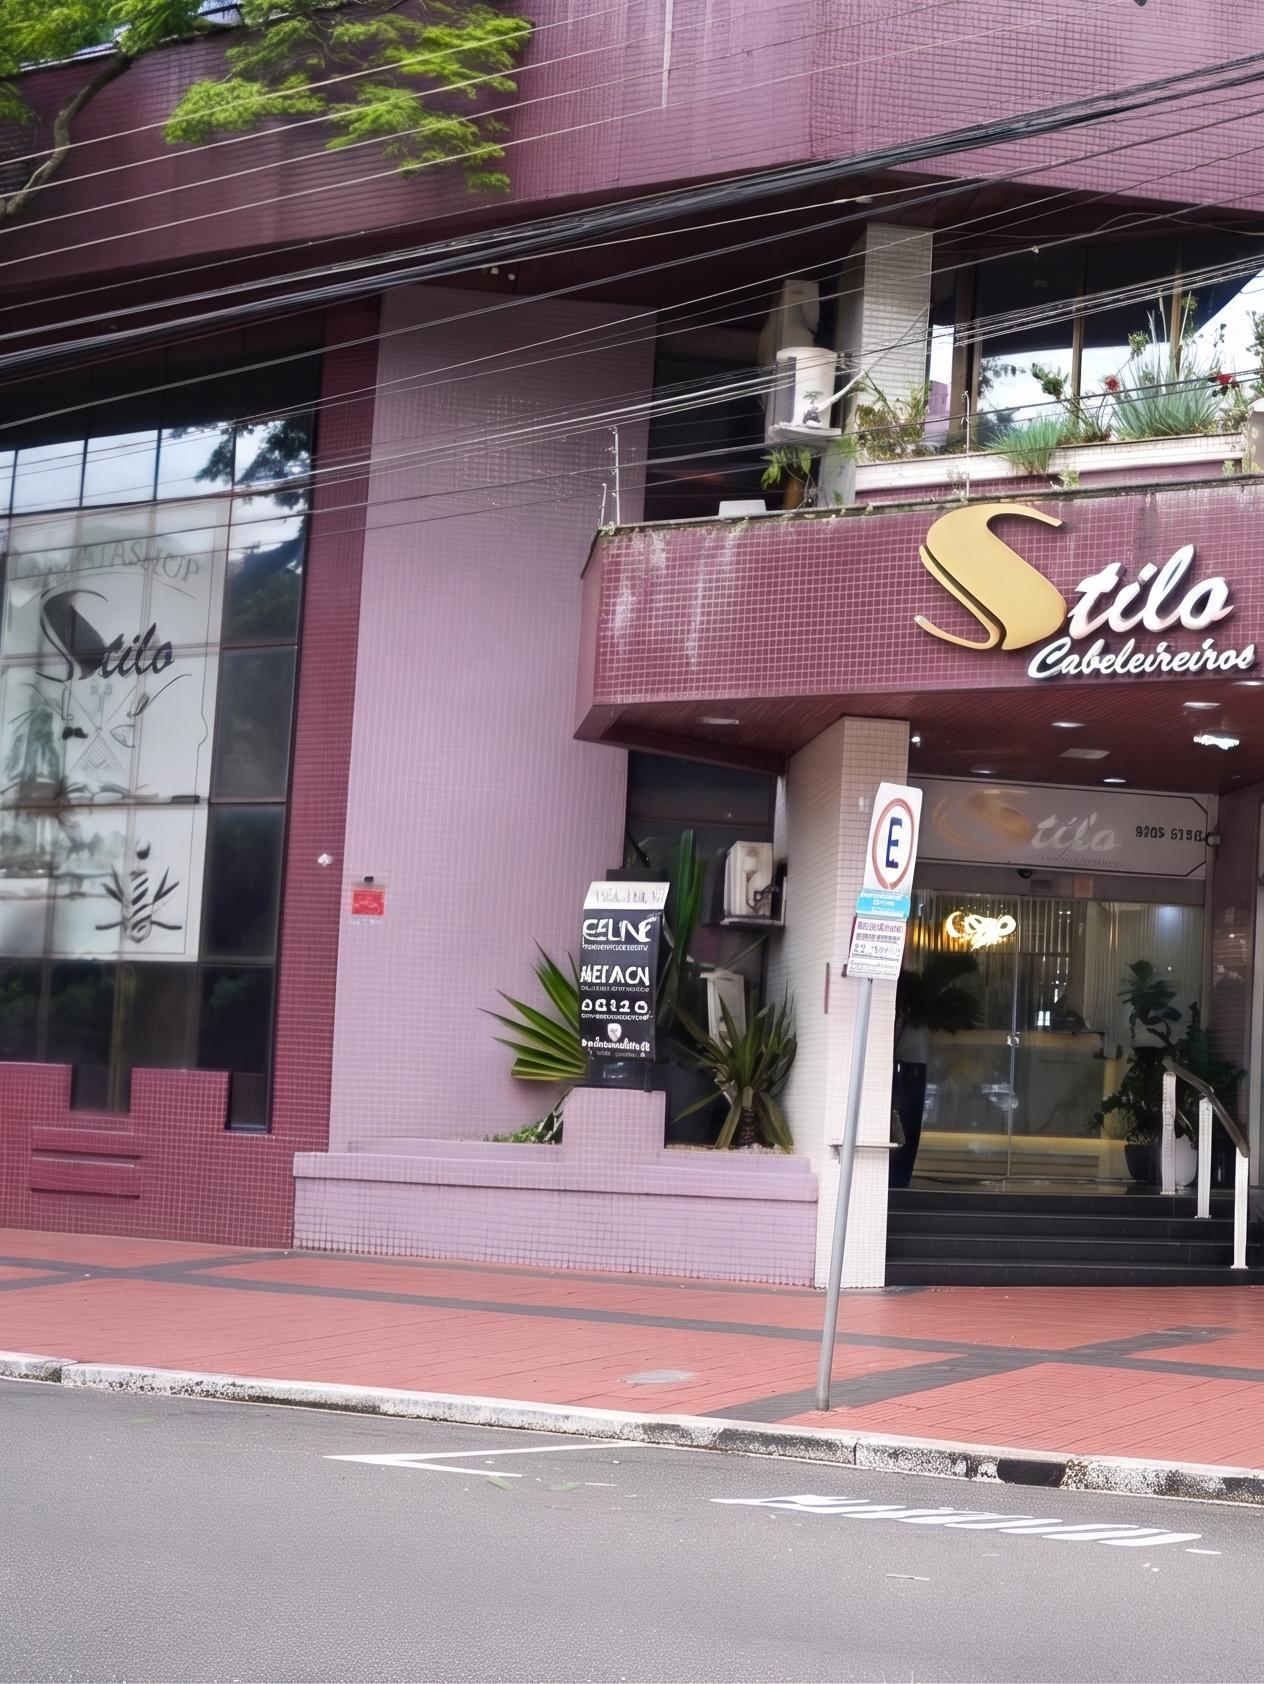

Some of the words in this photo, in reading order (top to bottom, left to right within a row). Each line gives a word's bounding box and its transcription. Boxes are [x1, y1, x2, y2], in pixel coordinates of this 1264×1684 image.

[914, 503, 1235, 651] Stilo
[1027, 636, 1256, 679] Cabeleireiros
[885, 816, 902, 869] E
[931, 788, 1122, 851] Stilo
